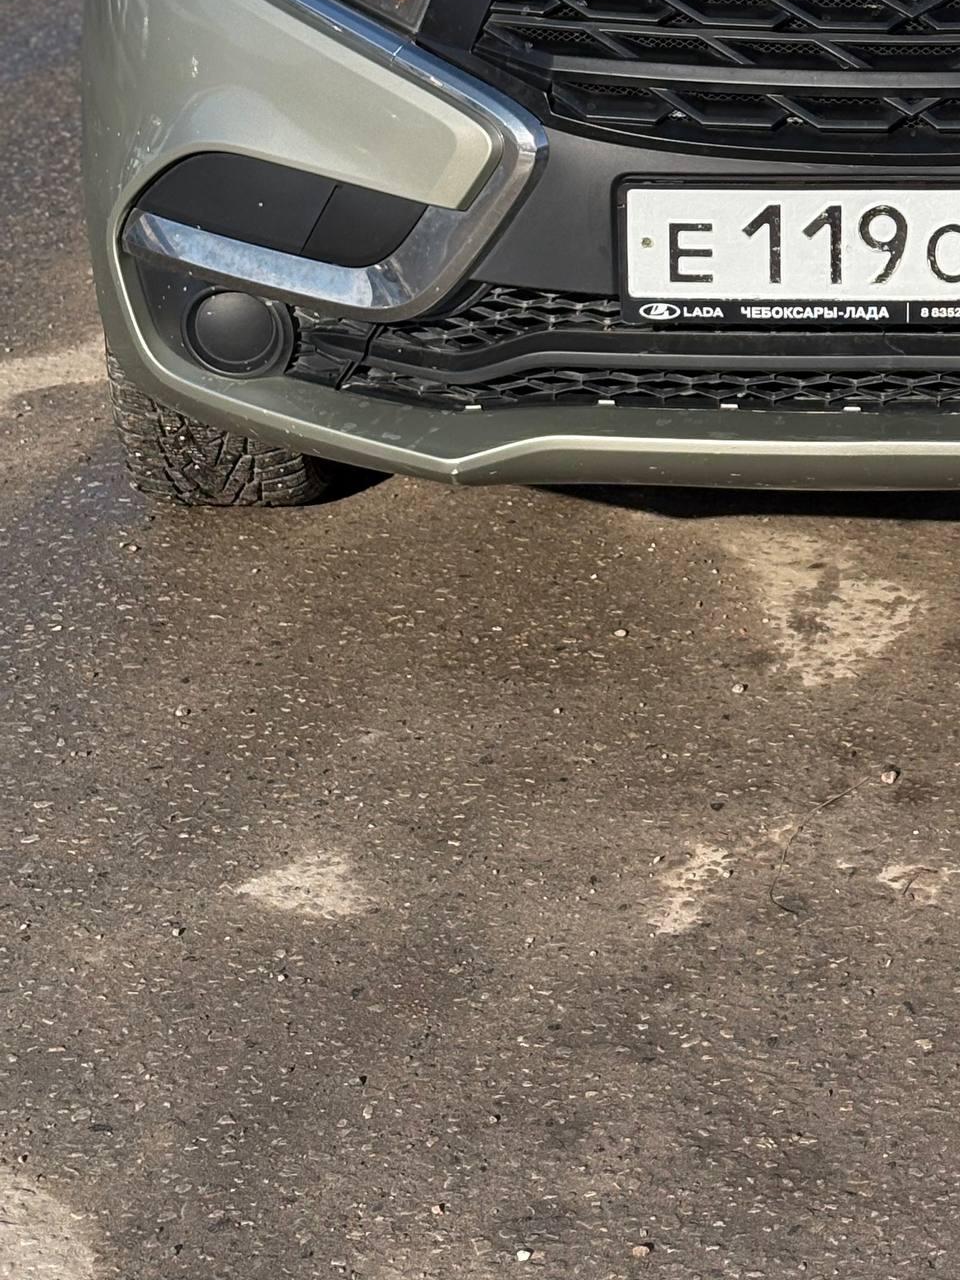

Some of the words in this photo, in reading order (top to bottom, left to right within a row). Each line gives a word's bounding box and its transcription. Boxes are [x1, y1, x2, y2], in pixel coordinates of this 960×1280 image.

[683, 306, 724, 318] LADA
[740, 306, 890, 321] ЧЕБОКСАРЫ-ЛАДА
[920, 306, 930, 318] 8
